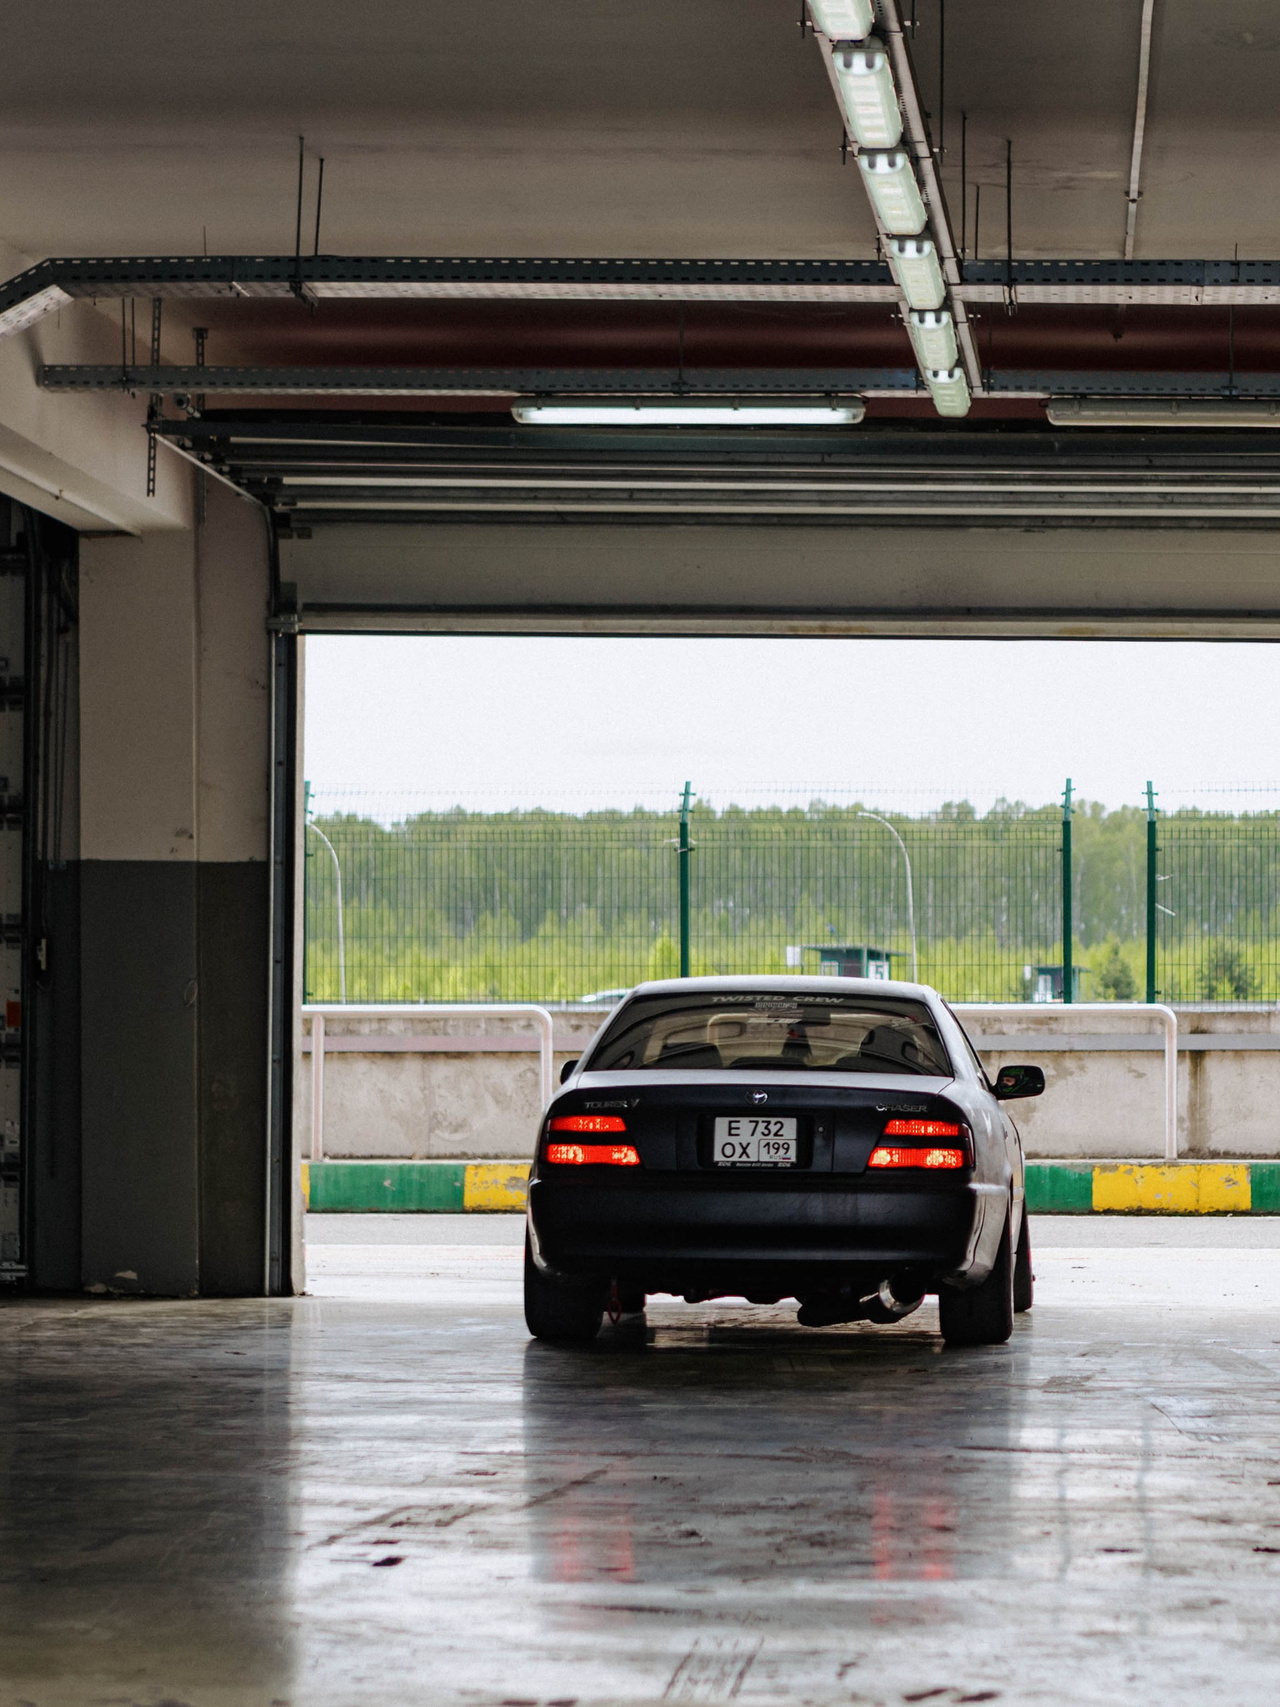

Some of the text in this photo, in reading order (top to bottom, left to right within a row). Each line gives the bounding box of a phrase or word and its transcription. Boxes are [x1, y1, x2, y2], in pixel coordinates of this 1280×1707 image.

[711, 995, 845, 1004] TWISTED CREW
[876, 1103, 929, 1113] CHASER
[728, 1120, 785, 1137] E 732
[721, 1142, 751, 1159] OX
[762, 1141, 791, 1155] 199
